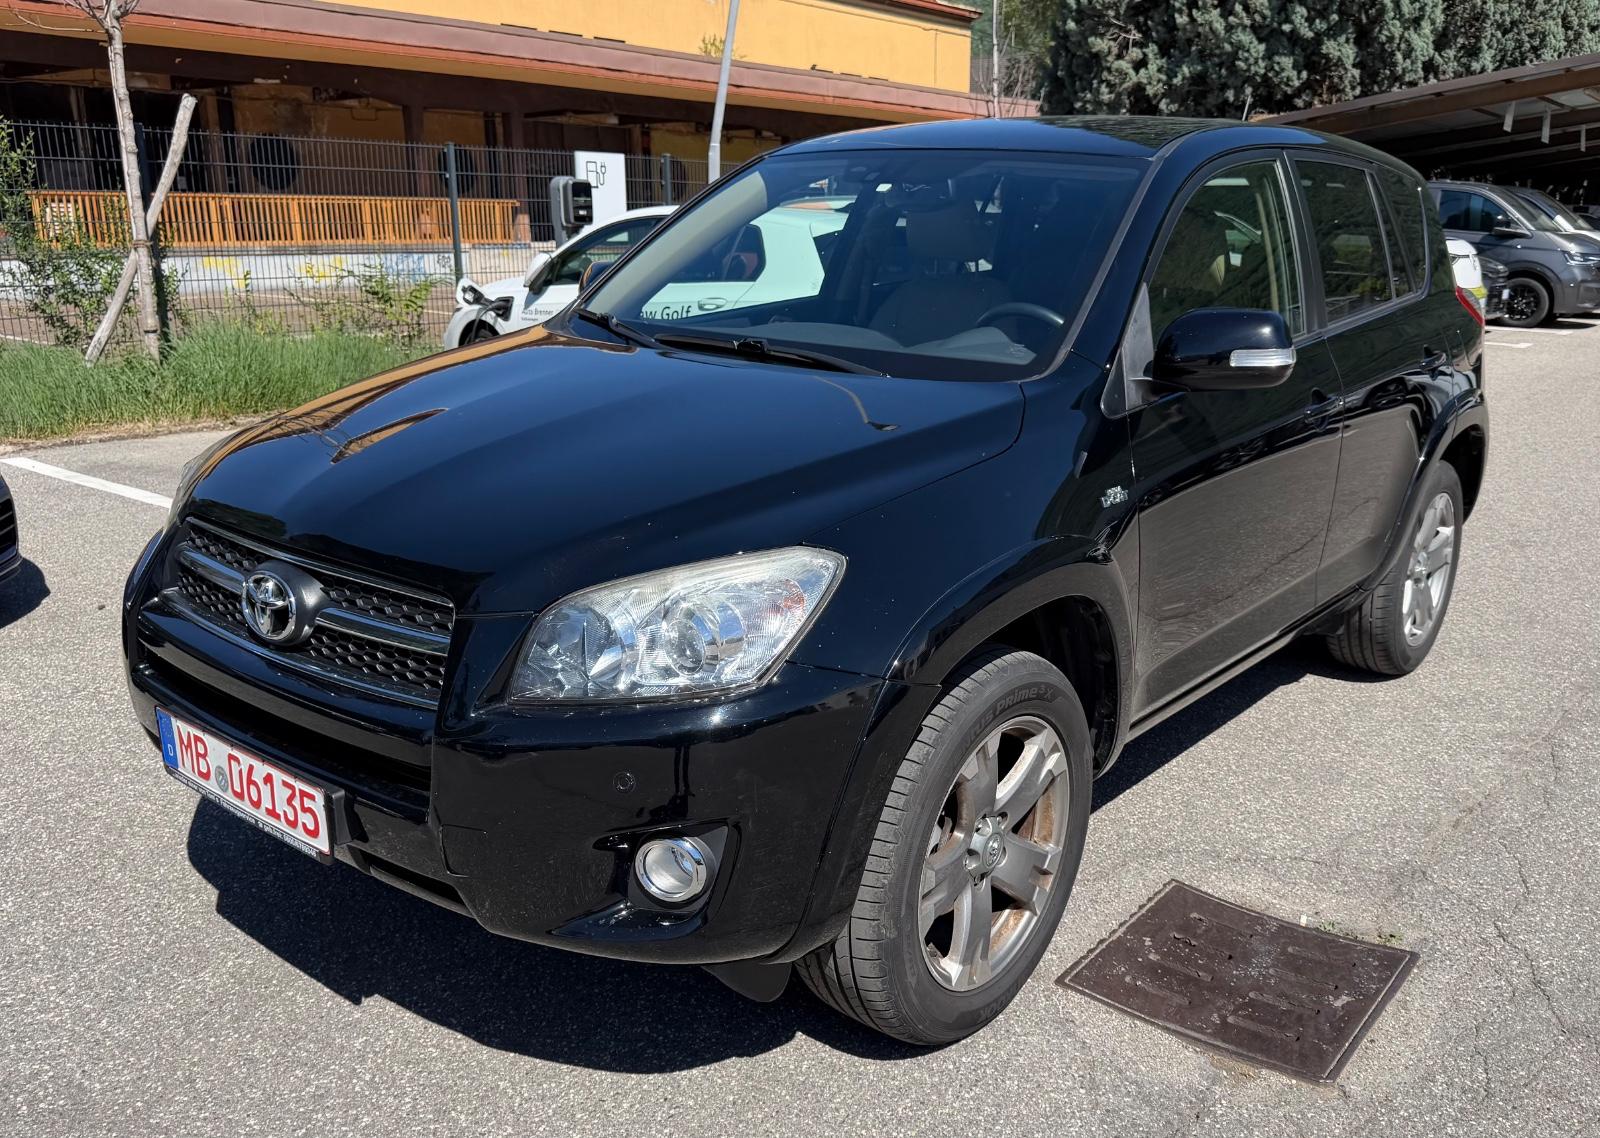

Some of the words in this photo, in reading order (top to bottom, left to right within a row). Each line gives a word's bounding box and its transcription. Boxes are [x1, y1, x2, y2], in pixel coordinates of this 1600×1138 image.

[661, 305, 692, 320] Golf
[177, 725, 211, 781] MB
[228, 752, 320, 838] 06135
